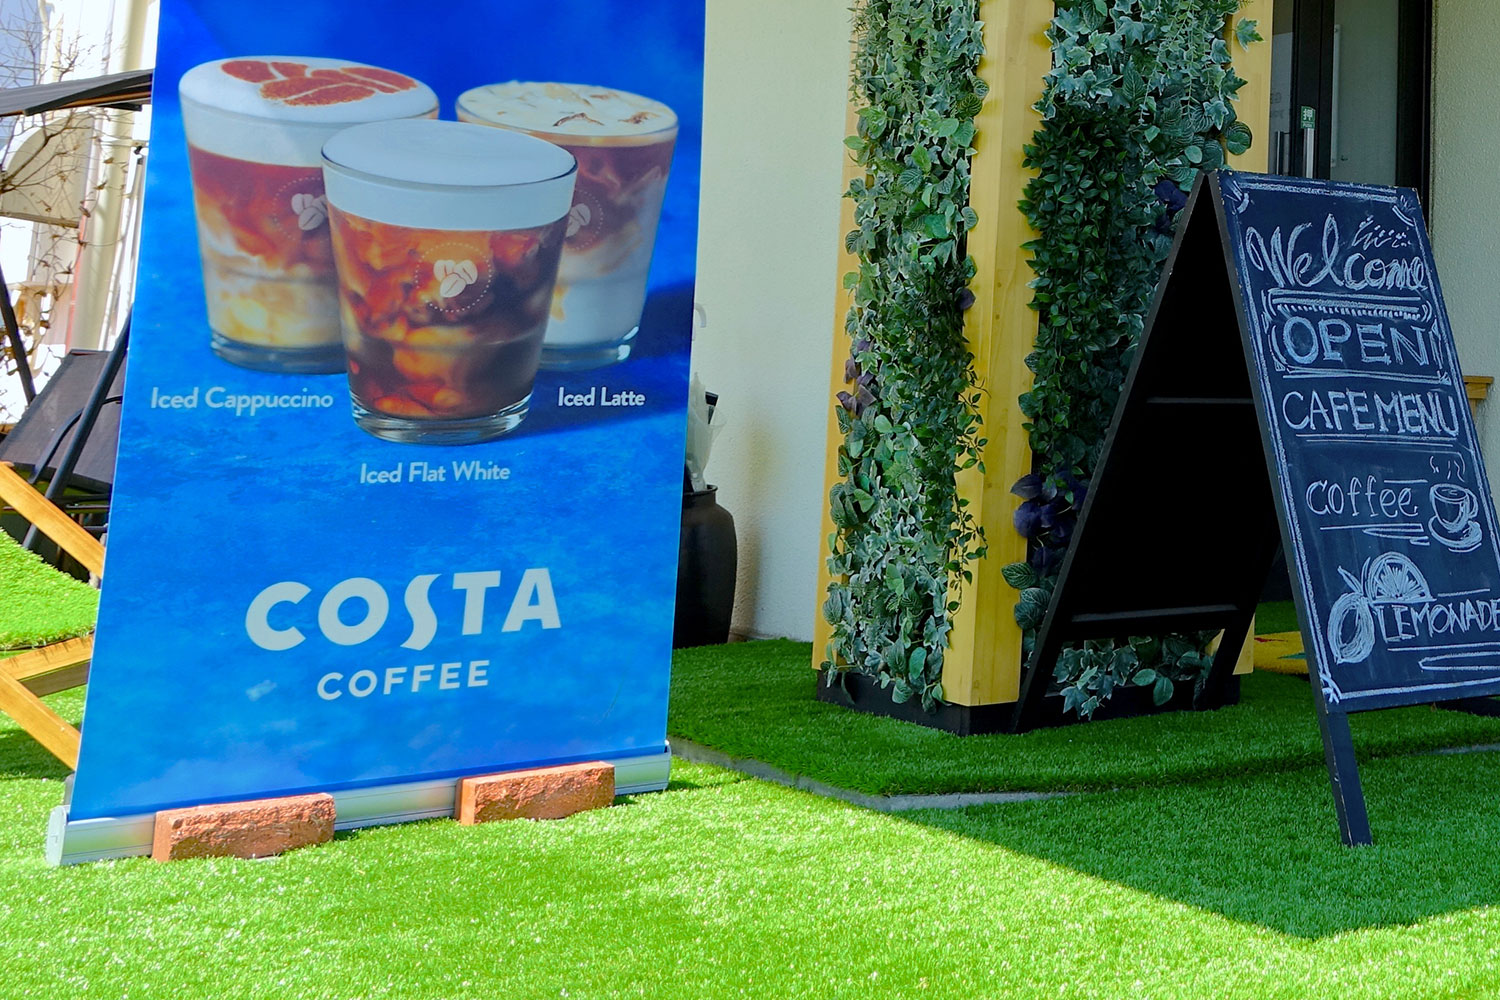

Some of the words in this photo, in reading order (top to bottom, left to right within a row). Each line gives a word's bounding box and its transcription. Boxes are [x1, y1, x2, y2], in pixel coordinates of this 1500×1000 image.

[1246, 213, 1428, 291] Welcome
[1283, 316, 1429, 366] OPEN
[150, 387, 199, 410] Iced
[205, 386, 334, 417] Cappuccino
[557, 387, 596, 408] Iced
[601, 387, 646, 408] Latte
[360, 463, 402, 485] Iced
[408, 462, 446, 484] Flat
[452, 461, 511, 483] White
[244, 568, 562, 651] COSTA
[316, 659, 491, 702] COFFEE
